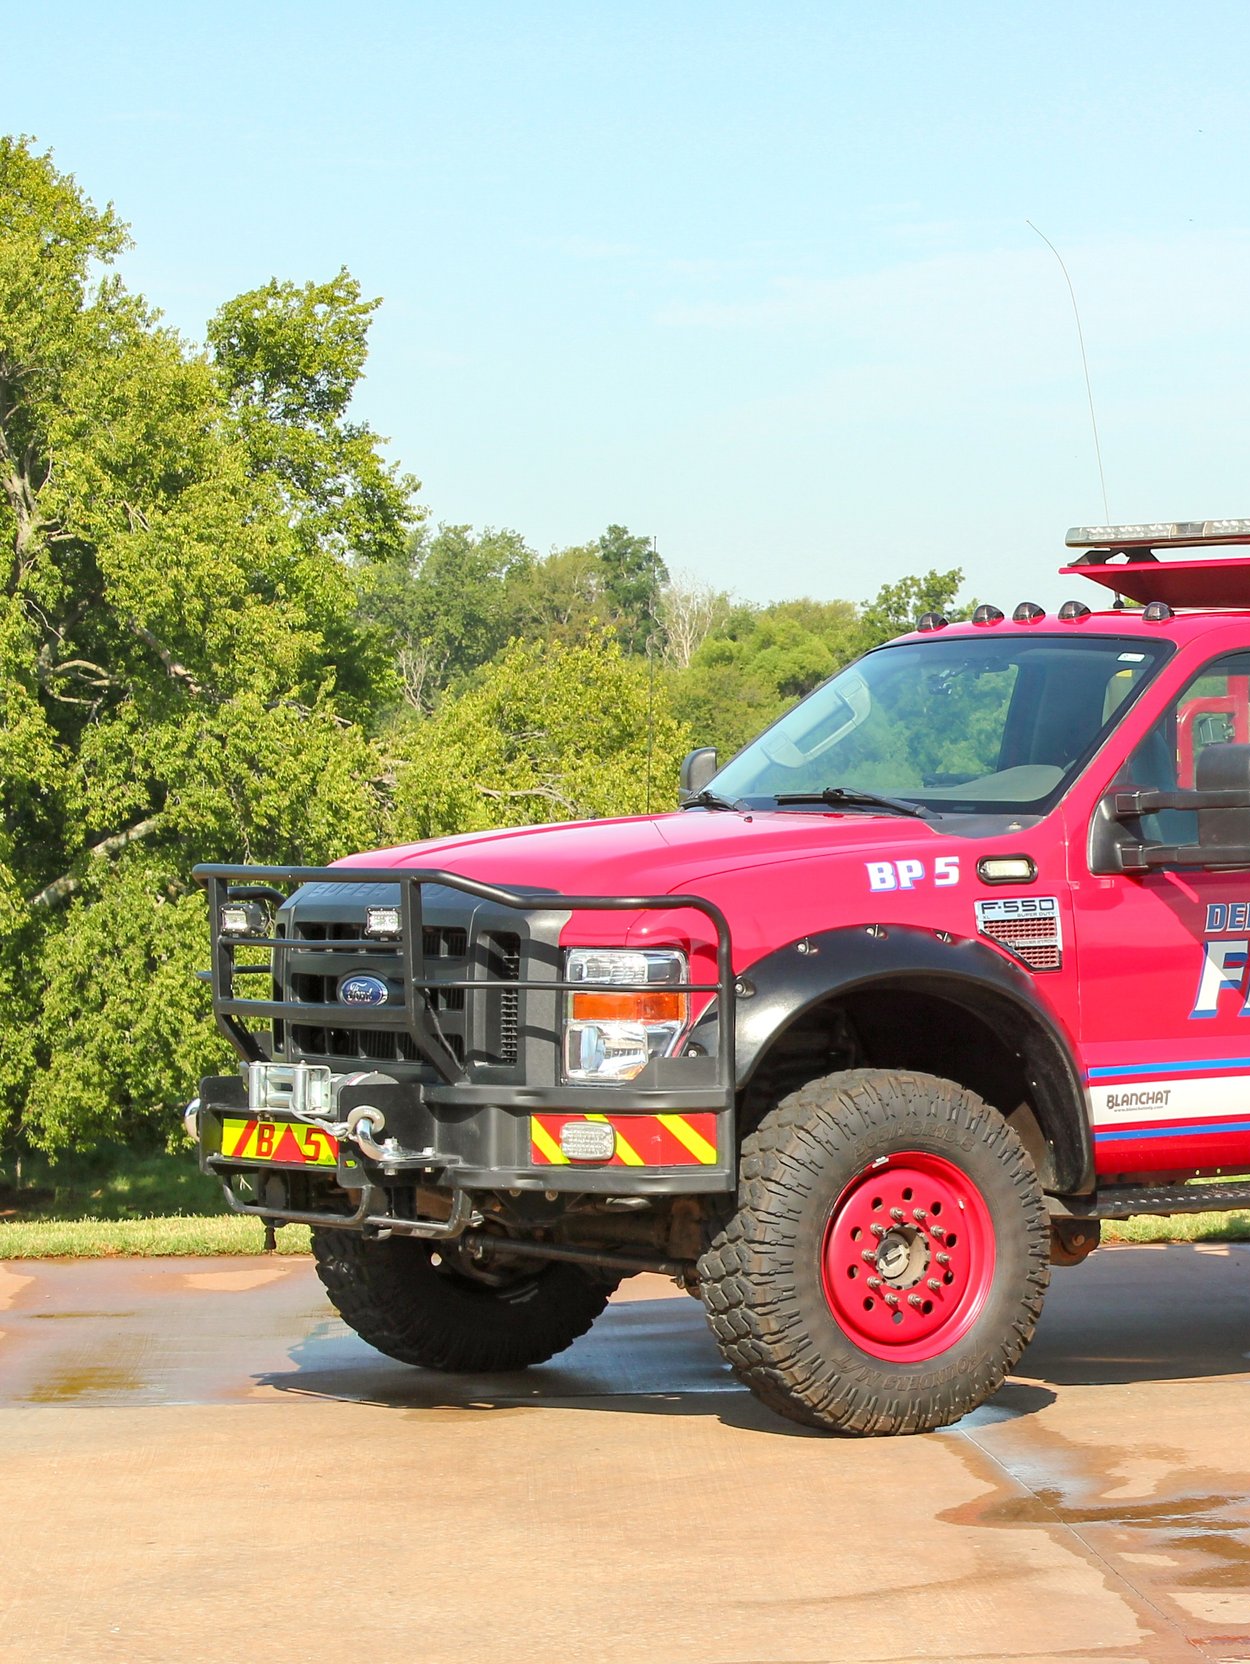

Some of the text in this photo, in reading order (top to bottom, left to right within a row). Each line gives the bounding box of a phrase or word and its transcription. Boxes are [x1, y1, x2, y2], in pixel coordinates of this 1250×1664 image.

[864, 856, 960, 892] BP 5
[1106, 1089, 1172, 1110] BLANCHAT
[301, 1127, 321, 1161] 5
